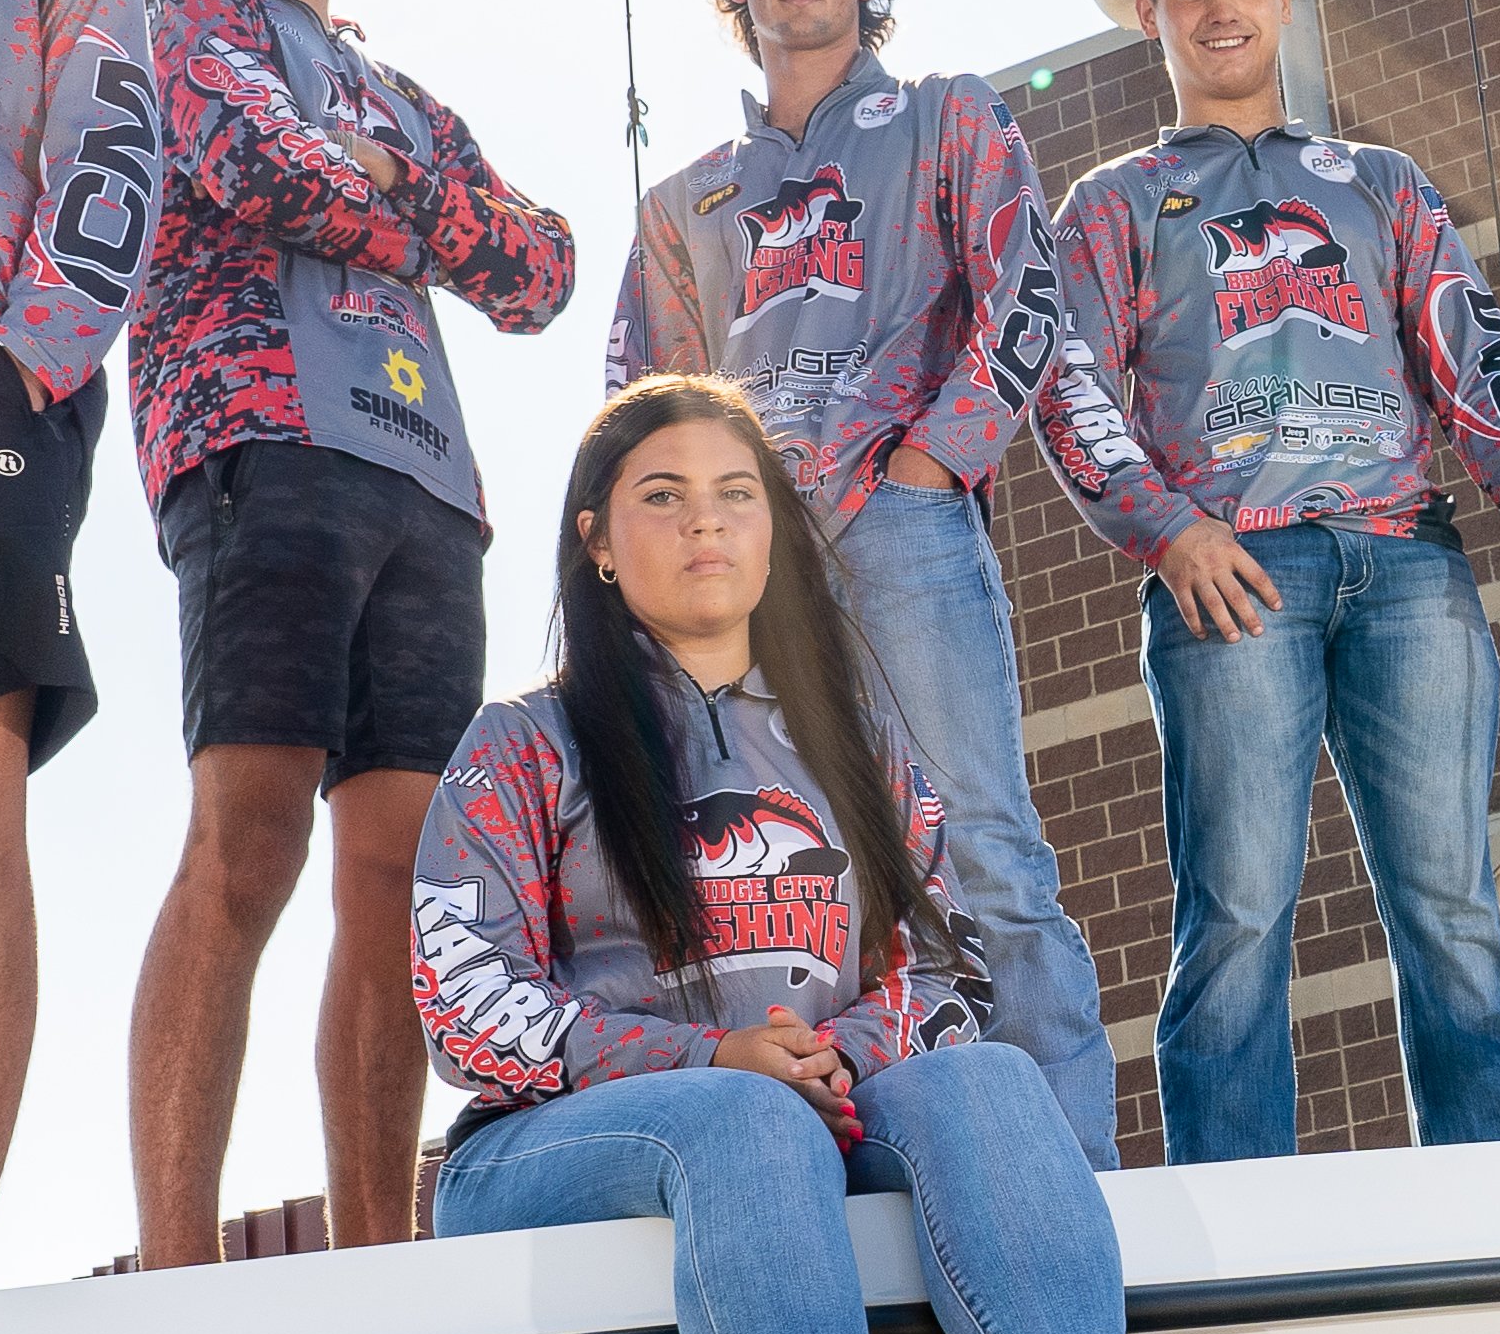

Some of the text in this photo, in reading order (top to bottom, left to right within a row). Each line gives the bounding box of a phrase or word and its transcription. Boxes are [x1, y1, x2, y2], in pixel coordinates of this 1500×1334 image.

[329, 290, 378, 315] GOLF
[340, 312, 364, 325] OF
[1214, 271, 1369, 341] FISHING
[350, 386, 450, 458] SUNBELT
[1204, 378, 1406, 434] GRANGER
[370, 415, 442, 463] RENTALS
[1285, 427, 1371, 446] Jeep RAM
[1236, 505, 1296, 533] GOLF
[773, 875, 834, 901] CITY
[414, 878, 585, 1064] RAMBO
